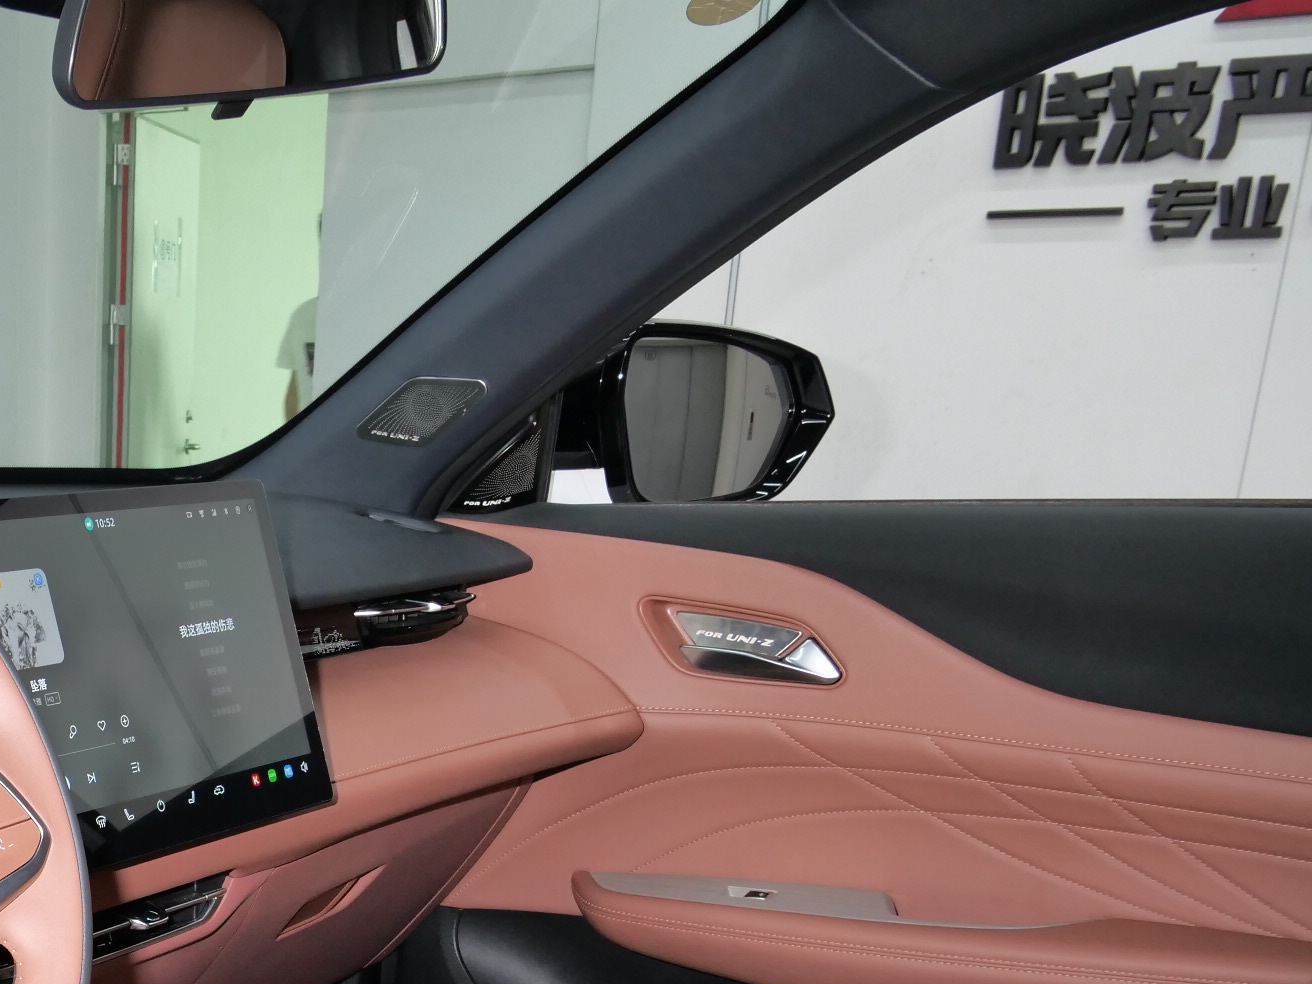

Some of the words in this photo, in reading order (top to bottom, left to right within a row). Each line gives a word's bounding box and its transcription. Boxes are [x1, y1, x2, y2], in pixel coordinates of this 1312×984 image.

[993, 53, 1312, 170] 晓波严
[1147, 175, 1290, 242] 专业
[95, 517, 115, 528] 10:52
[179, 617, 236, 639] 我这孤独的伤悲
[695, 629, 723, 639] FOR
